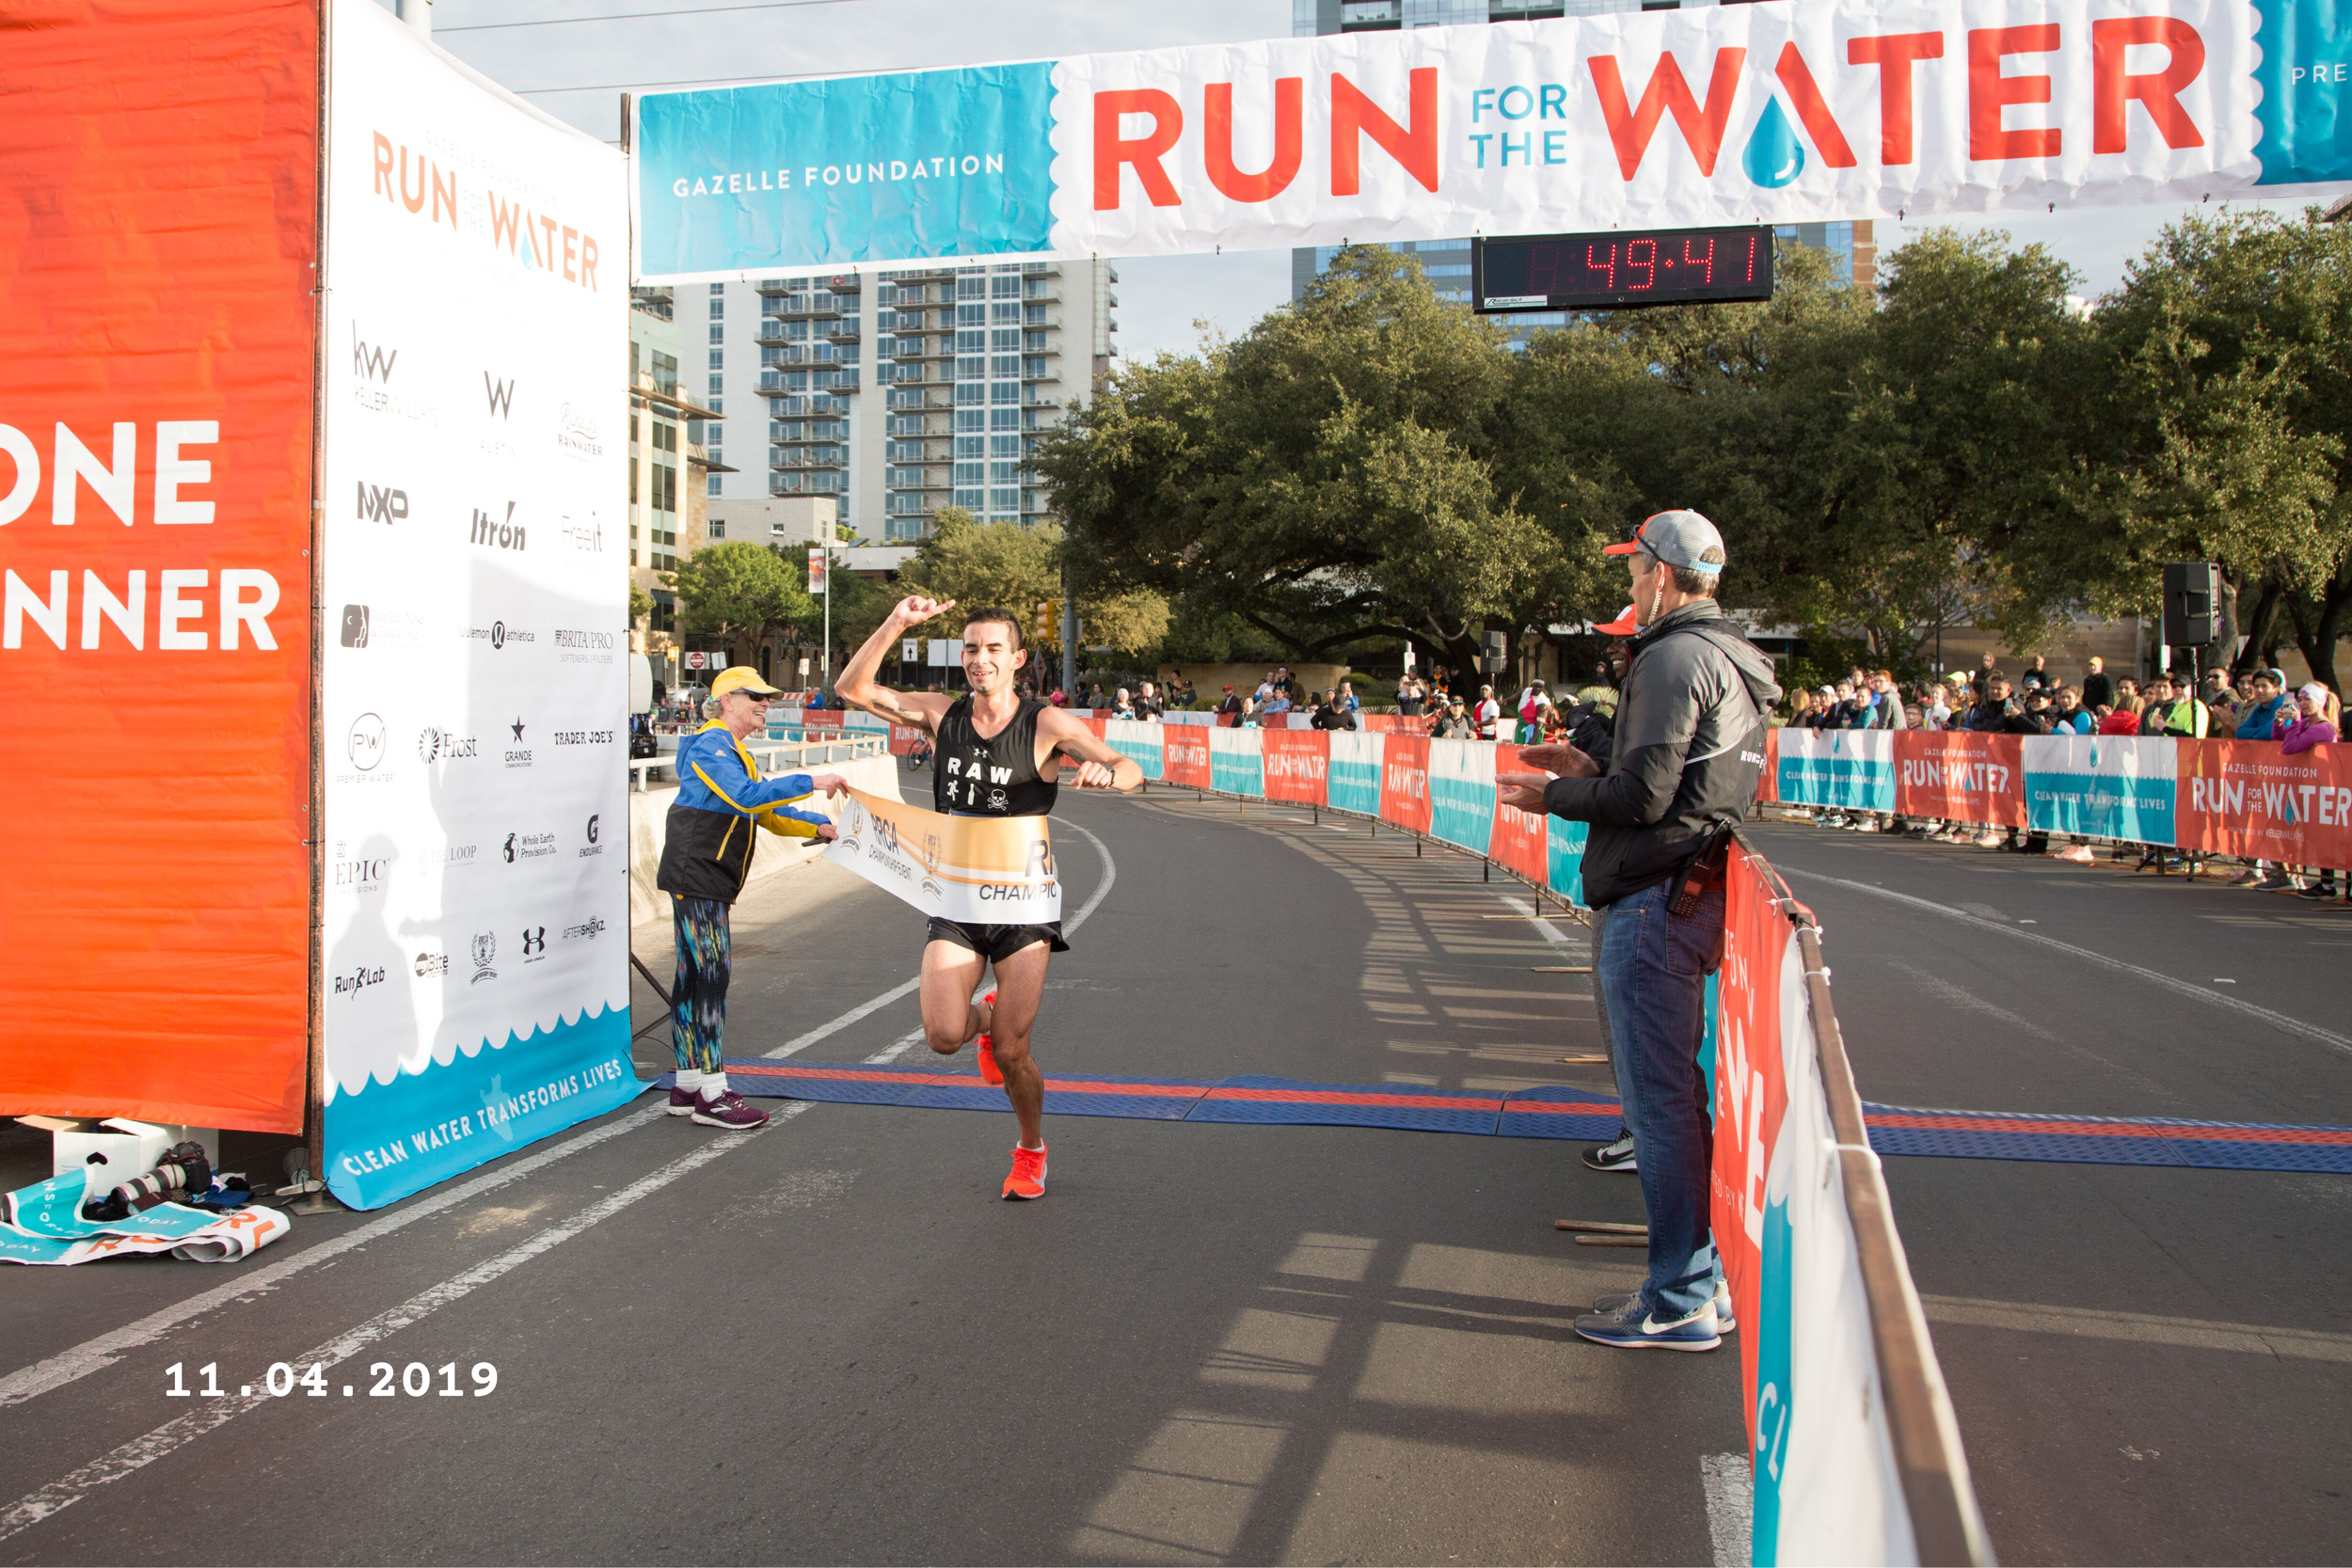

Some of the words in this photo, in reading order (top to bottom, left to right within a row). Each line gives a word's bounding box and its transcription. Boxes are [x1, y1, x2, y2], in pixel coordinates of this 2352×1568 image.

[2292, 63, 2347, 86] PRE
[1093, 66, 1438, 211] RUN
[1587, 16, 2206, 182] WATER
[1471, 84, 1567, 123] FOR
[1469, 130, 1567, 169] THE
[673, 168, 790, 198] GAZELLE
[804, 153, 1005, 188] FOUNDATION
[373, 129, 457, 232] RUN
[487, 189, 599, 293] WATER
[484, 371, 515, 422] W
[558, 434, 603, 457] RAINWATER
[358, 481, 409, 525] NXP
[3, 568, 280, 650] NNER
[506, 629, 535, 642] athletica
[443, 733, 477, 758] Frost
[554, 732, 586, 745] TRADER
[588, 730, 613, 744] JOE'S
[505, 750, 532, 762] GRANDE
[947, 756, 1012, 786] RAW
[1903, 759, 1941, 787] RUN
[1949, 761, 2011, 794] WATER
[2222, 762, 2256, 774] GAZELLE
[2258, 765, 2317, 779] FOUNDATION
[2139, 798, 2166, 811] LIVES
[2191, 777, 2245, 816] RUN
[2262, 782, 2352, 827] WATER
[2248, 788, 2262, 800] FOR
[2247, 800, 2263, 813] THE
[521, 835, 539, 847] Whole
[540, 832, 555, 843] Earth
[580, 845, 603, 858] ENDURANCE
[451, 845, 477, 861] LOOP
[520, 847, 548, 858] Provision
[336, 858, 388, 886] EPIC
[366, 966, 386, 987] Lab
[342, 1138, 409, 1177] CLEAN
[411, 1116, 473, 1154] WATER
[476, 1075, 580, 1130] TRANSFORMS
[582, 1059, 623, 1089] LIVES
